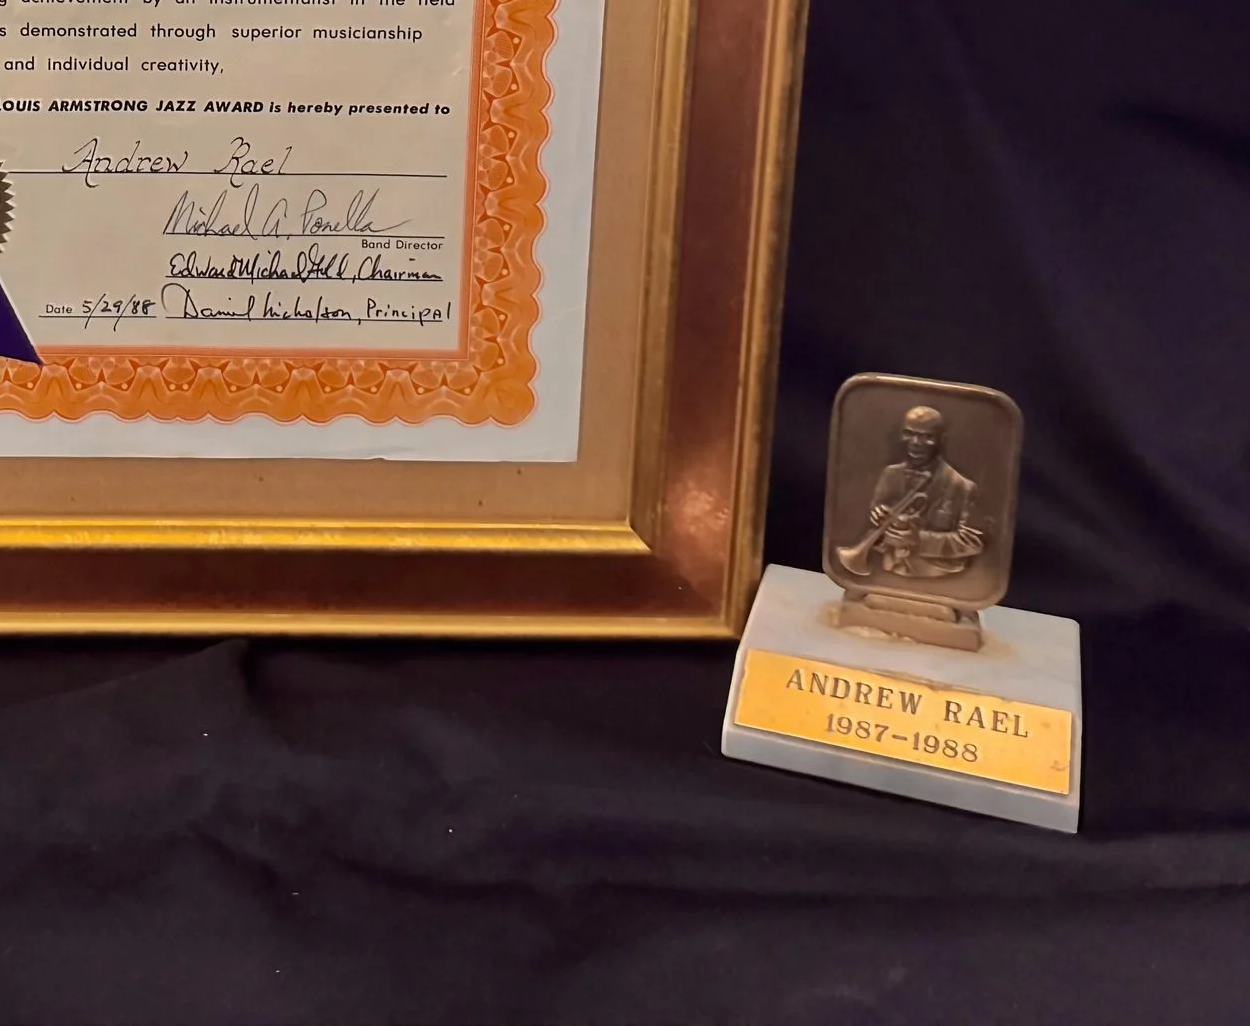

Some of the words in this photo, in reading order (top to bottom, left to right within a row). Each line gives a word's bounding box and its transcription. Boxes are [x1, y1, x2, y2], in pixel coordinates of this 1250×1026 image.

[19, 21, 137, 38] demonstrated
[150, 22, 216, 42] through
[231, 25, 302, 42] superior
[313, 25, 423, 44] musicianship
[3, 55, 35, 71] and
[47, 55, 129, 71] individual
[140, 58, 224, 76] creativity,
[47, 99, 148, 112] ARMSTRONG
[155, 99, 197, 112] JAZZ
[203, 100, 264, 113] AWARD
[269, 101, 282, 113] is
[287, 101, 344, 117] hereby
[348, 102, 430, 116] presented
[434, 104, 451, 115] to
[62, 138, 188, 188] Andrew
[214, 136, 292, 188] Rael
[163, 183, 259, 240] Michael
[362, 240, 390, 249] Band
[396, 240, 443, 250] Director
[358, 256, 442, 280] Chairman
[46, 304, 72, 314] Date
[82, 294, 156, 331] 5/29/88
[785, 669, 922, 715] ANDREW
[944, 700, 1029, 738] RAEL
[826, 713, 979, 763] 1987-1988
